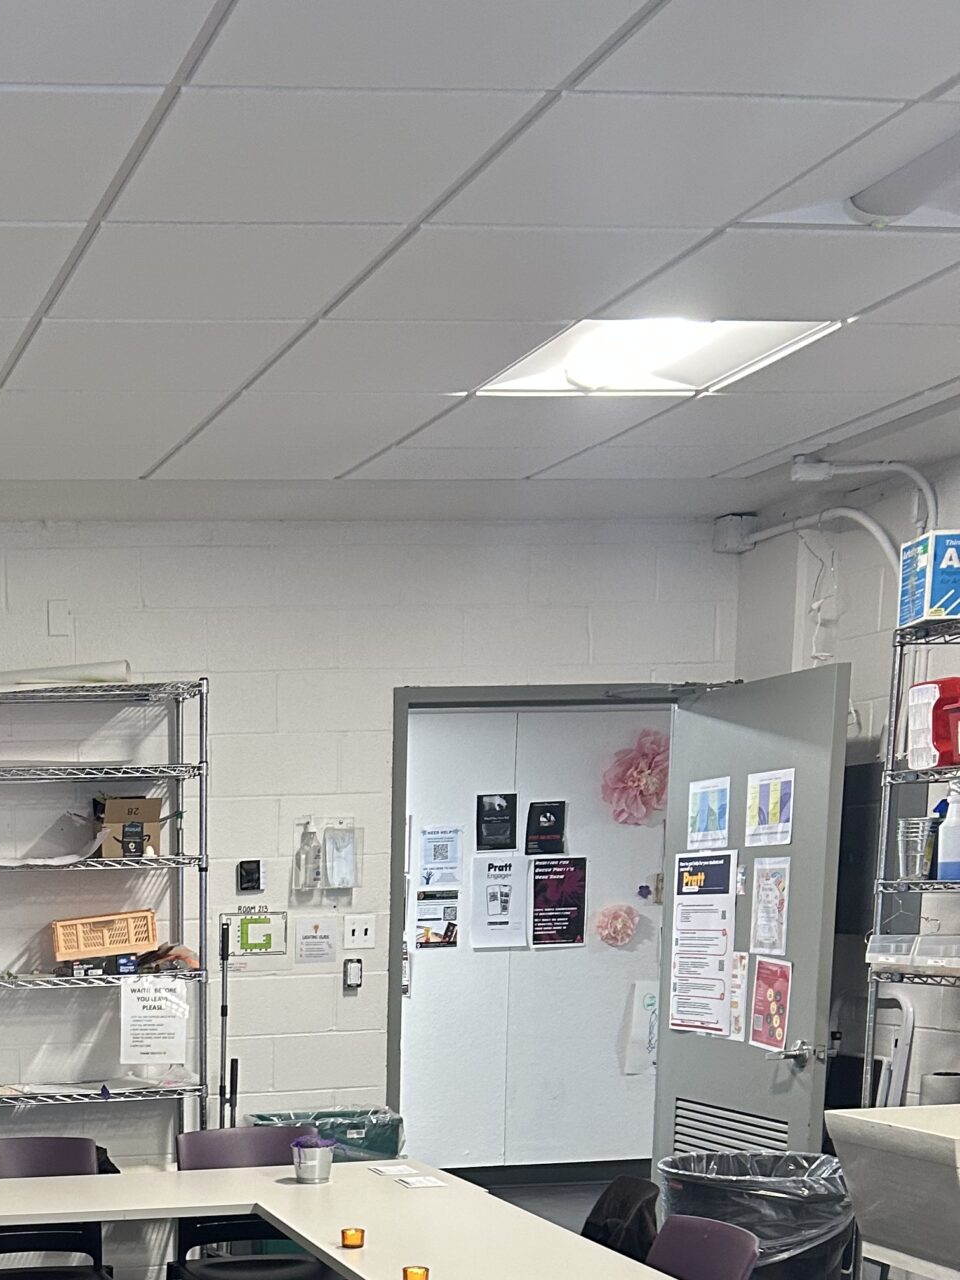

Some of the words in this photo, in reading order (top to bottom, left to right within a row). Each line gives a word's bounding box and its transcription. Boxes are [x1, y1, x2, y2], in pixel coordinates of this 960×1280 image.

[127, 807, 140, 816] 28
[487, 863, 512, 872] Pratt
[683, 872, 705, 887] Pratt
[238, 905, 256, 913] ROOM
